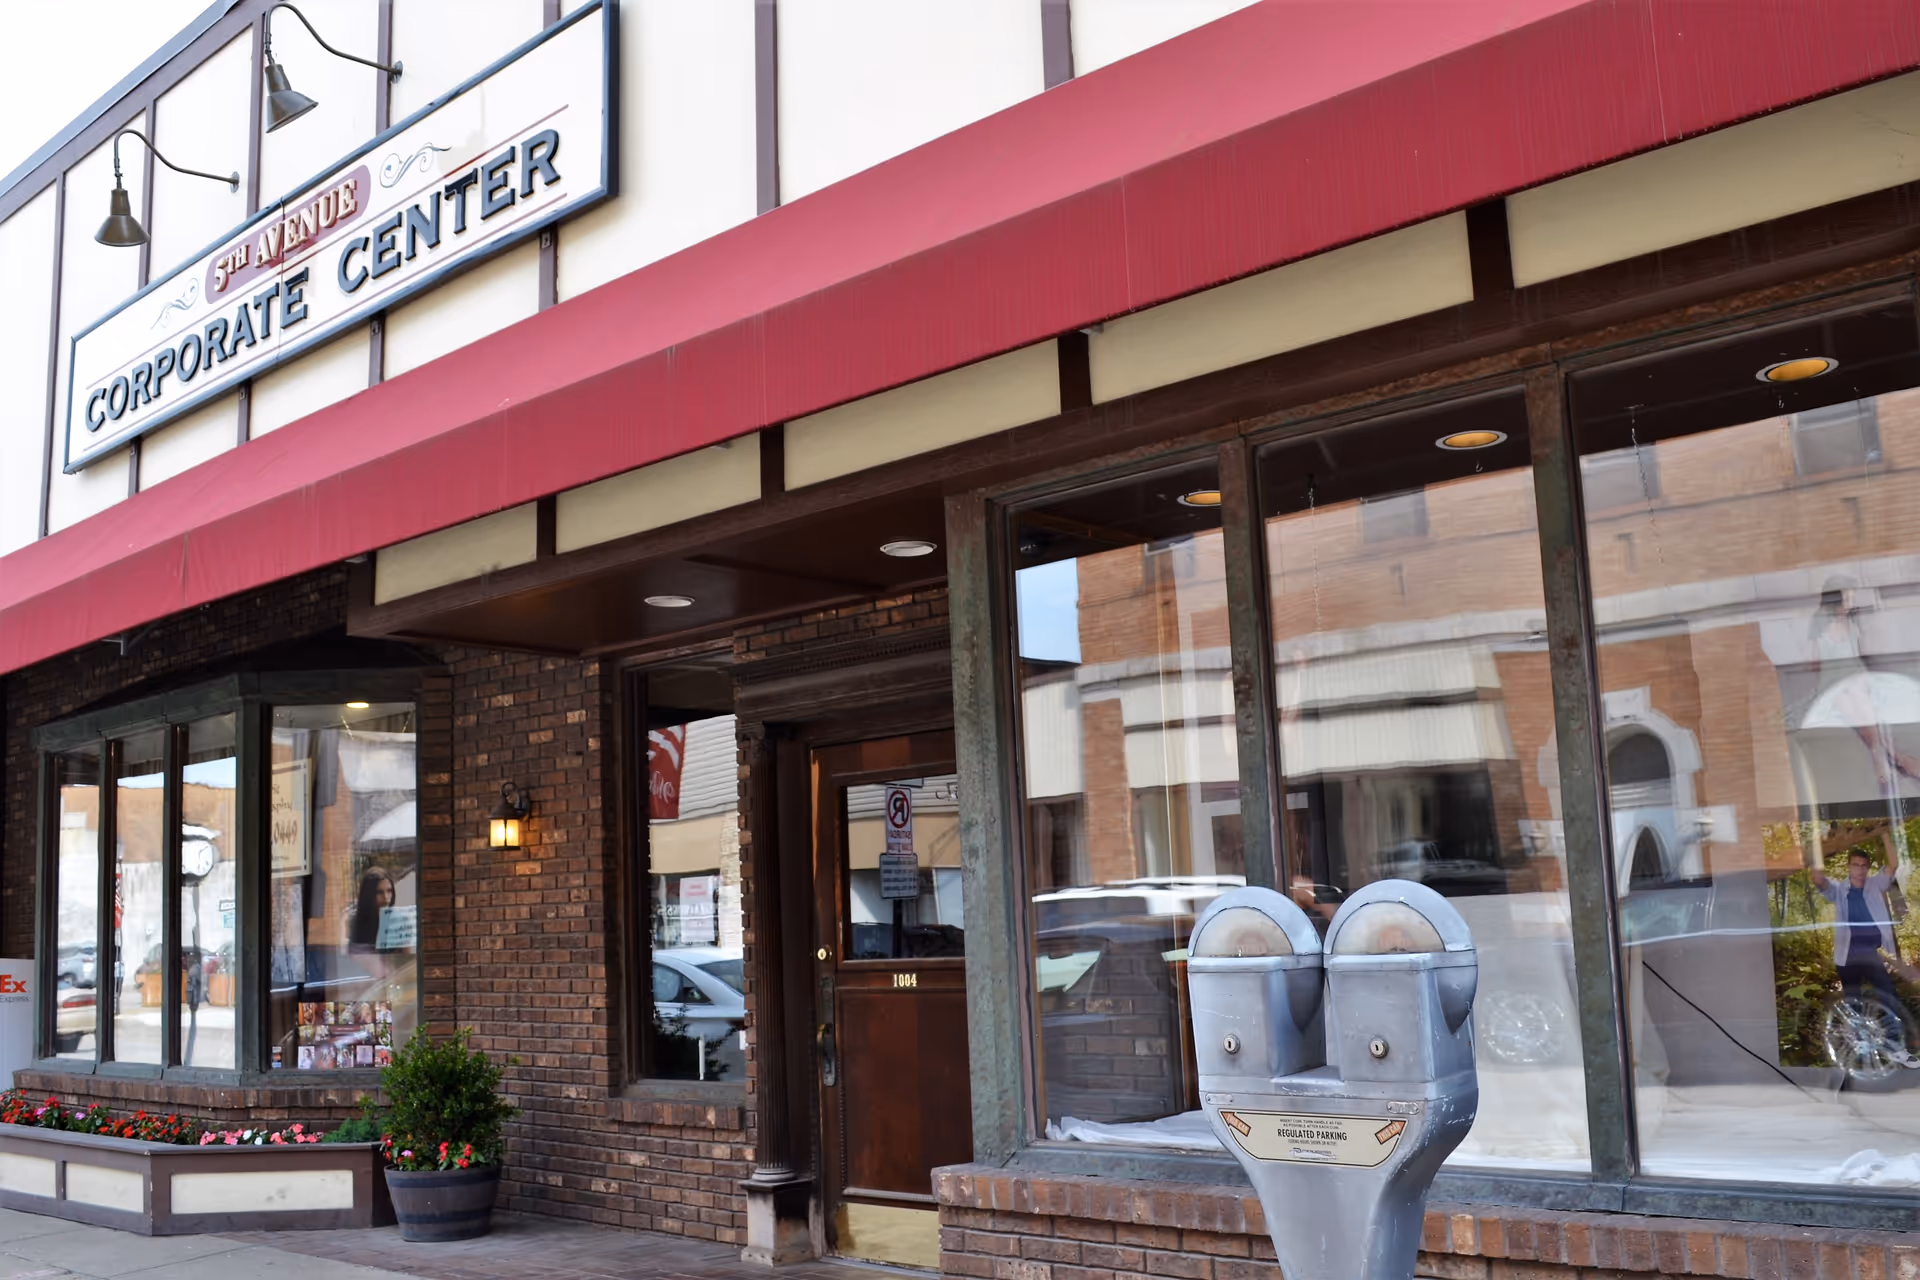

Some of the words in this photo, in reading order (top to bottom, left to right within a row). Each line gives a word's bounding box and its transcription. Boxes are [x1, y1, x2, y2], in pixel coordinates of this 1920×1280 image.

[214, 244, 250, 292] 5TH
[254, 179, 358, 268] AVENUE
[85, 267, 309, 432] CORPORATE
[337, 129, 561, 293] CENTER
[893, 973, 917, 987] 1004
[1277, 1129, 1315, 1139] REGULATED
[1316, 1131, 1348, 1141] PARKING
